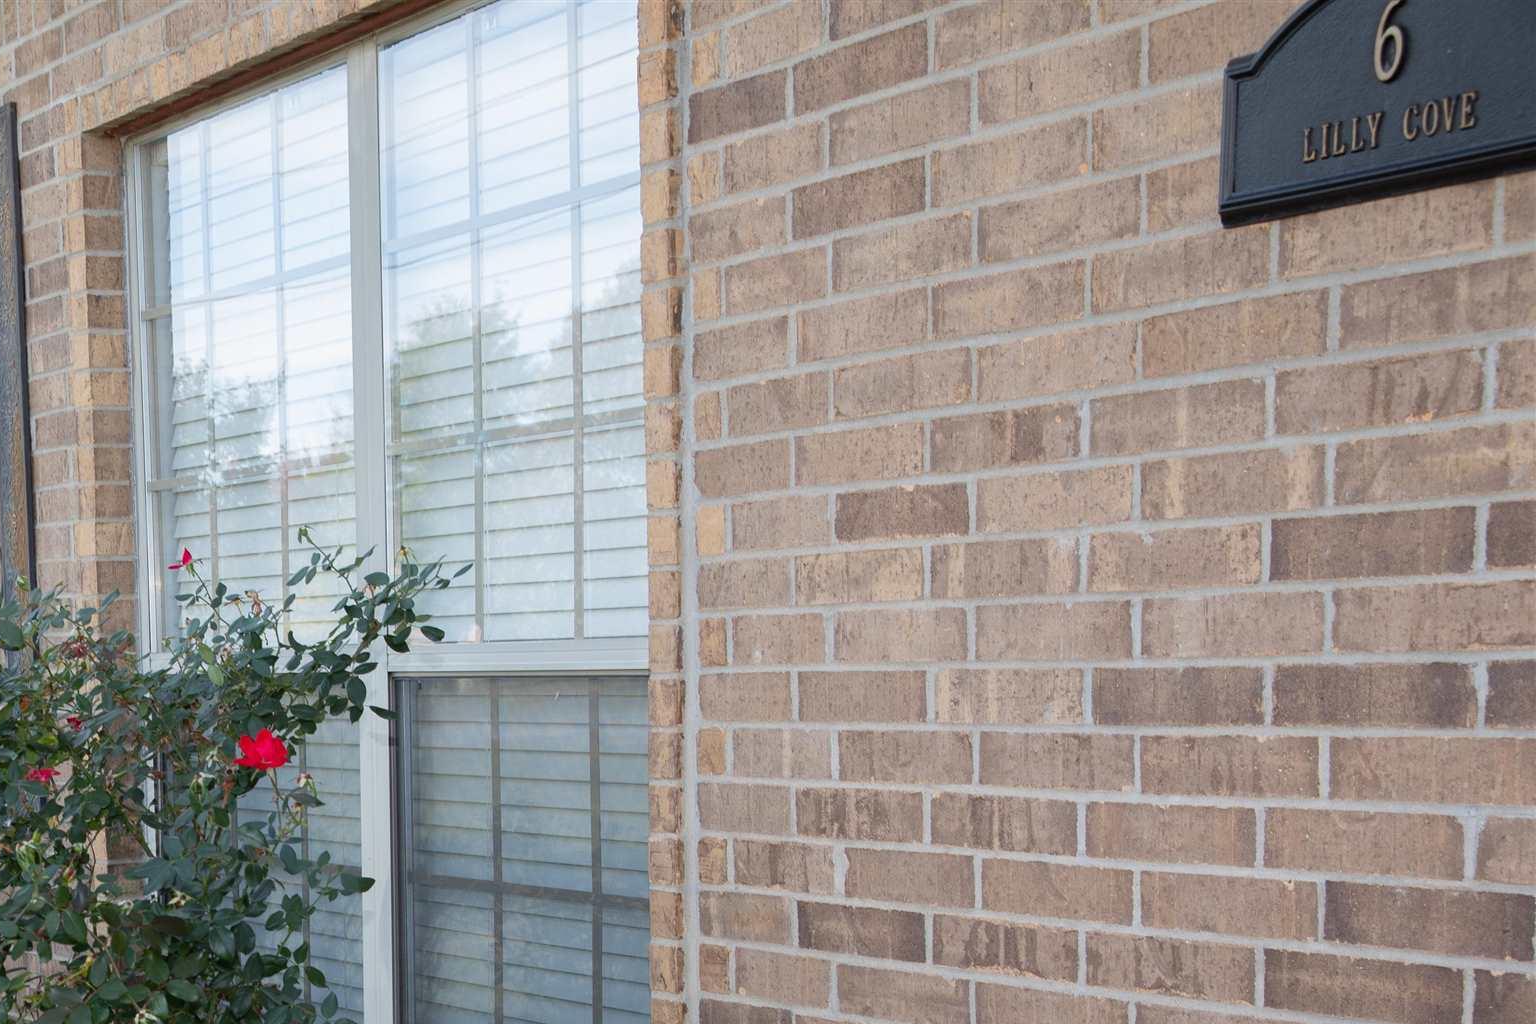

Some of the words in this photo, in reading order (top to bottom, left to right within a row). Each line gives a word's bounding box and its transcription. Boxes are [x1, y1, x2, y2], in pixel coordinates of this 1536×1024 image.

[1373, 0, 1405, 82] 6
[1302, 111, 1384, 164] LILLY
[1402, 90, 1478, 142] COVE
